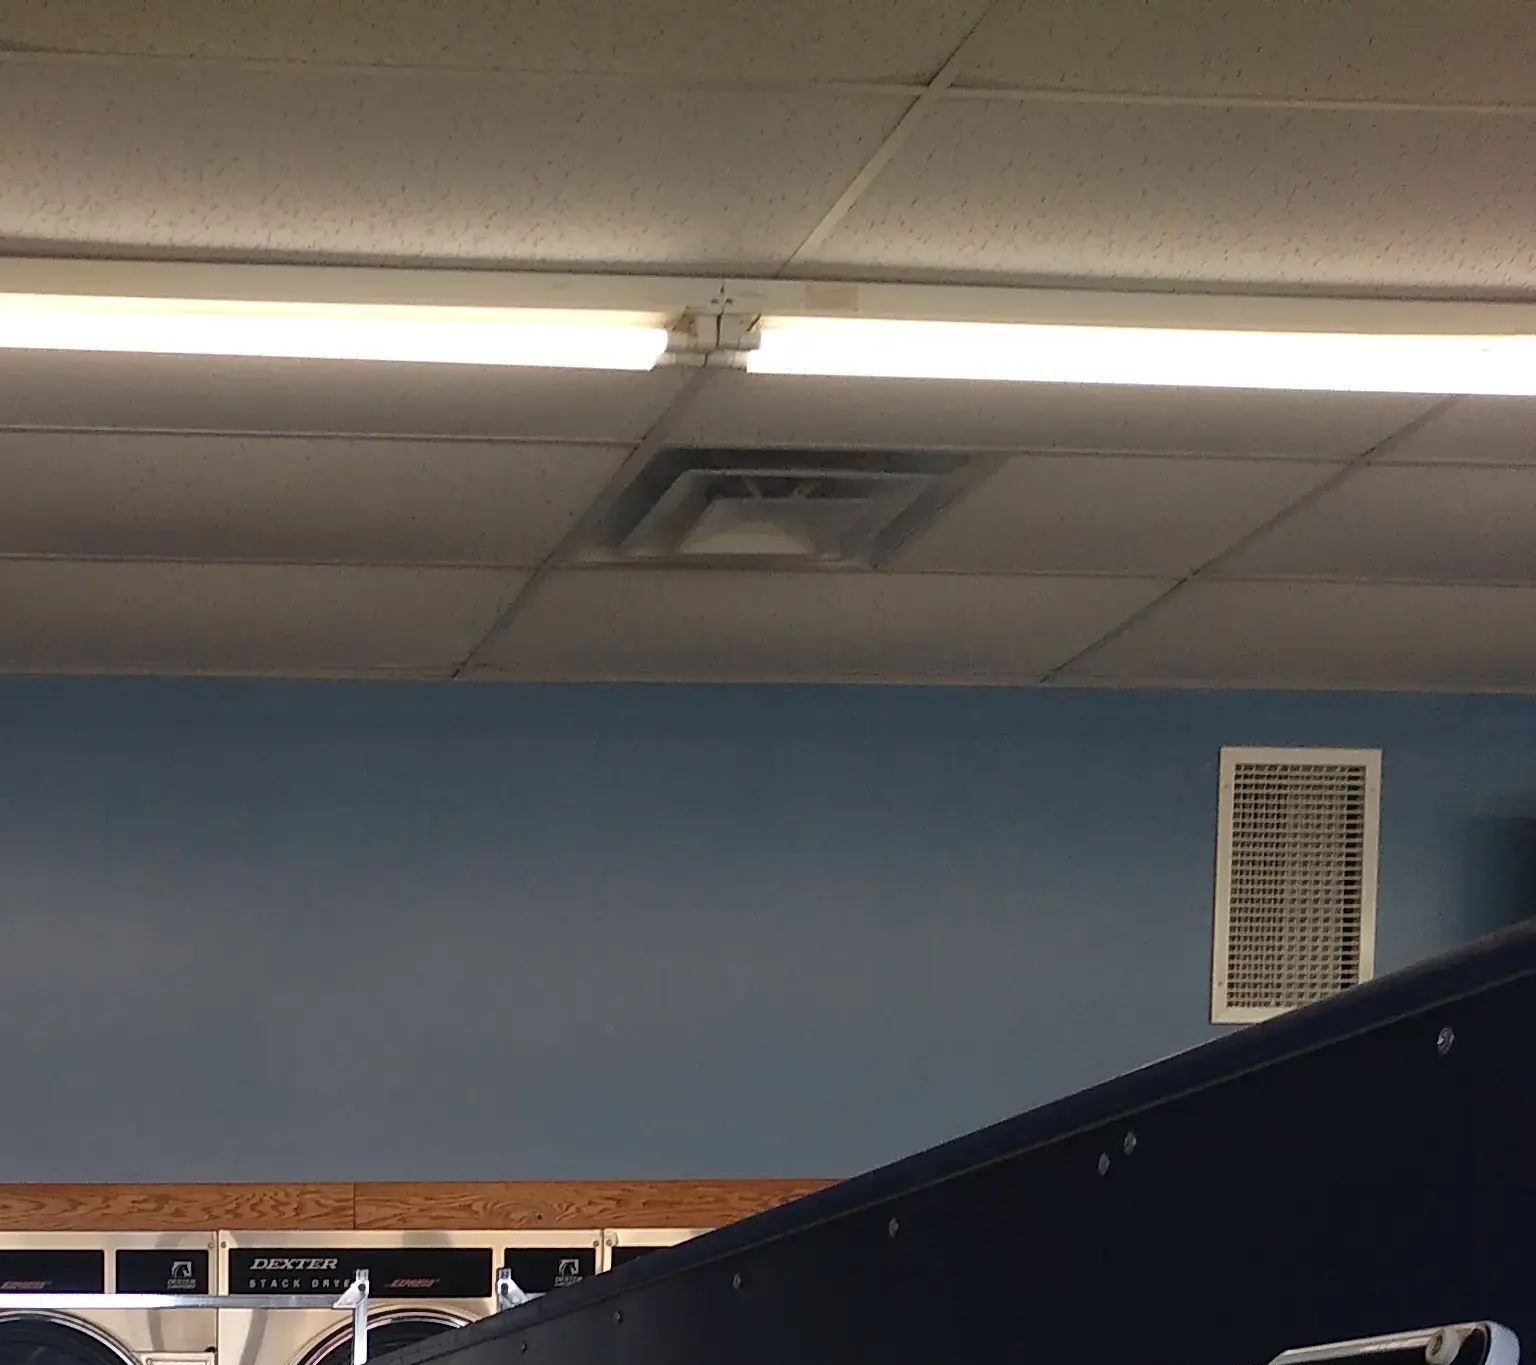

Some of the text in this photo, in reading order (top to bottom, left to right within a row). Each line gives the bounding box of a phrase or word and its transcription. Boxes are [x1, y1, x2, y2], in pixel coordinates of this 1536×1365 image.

[249, 1258, 338, 1270] DEXTER
[249, 1278, 352, 1289] STACK DRYE
